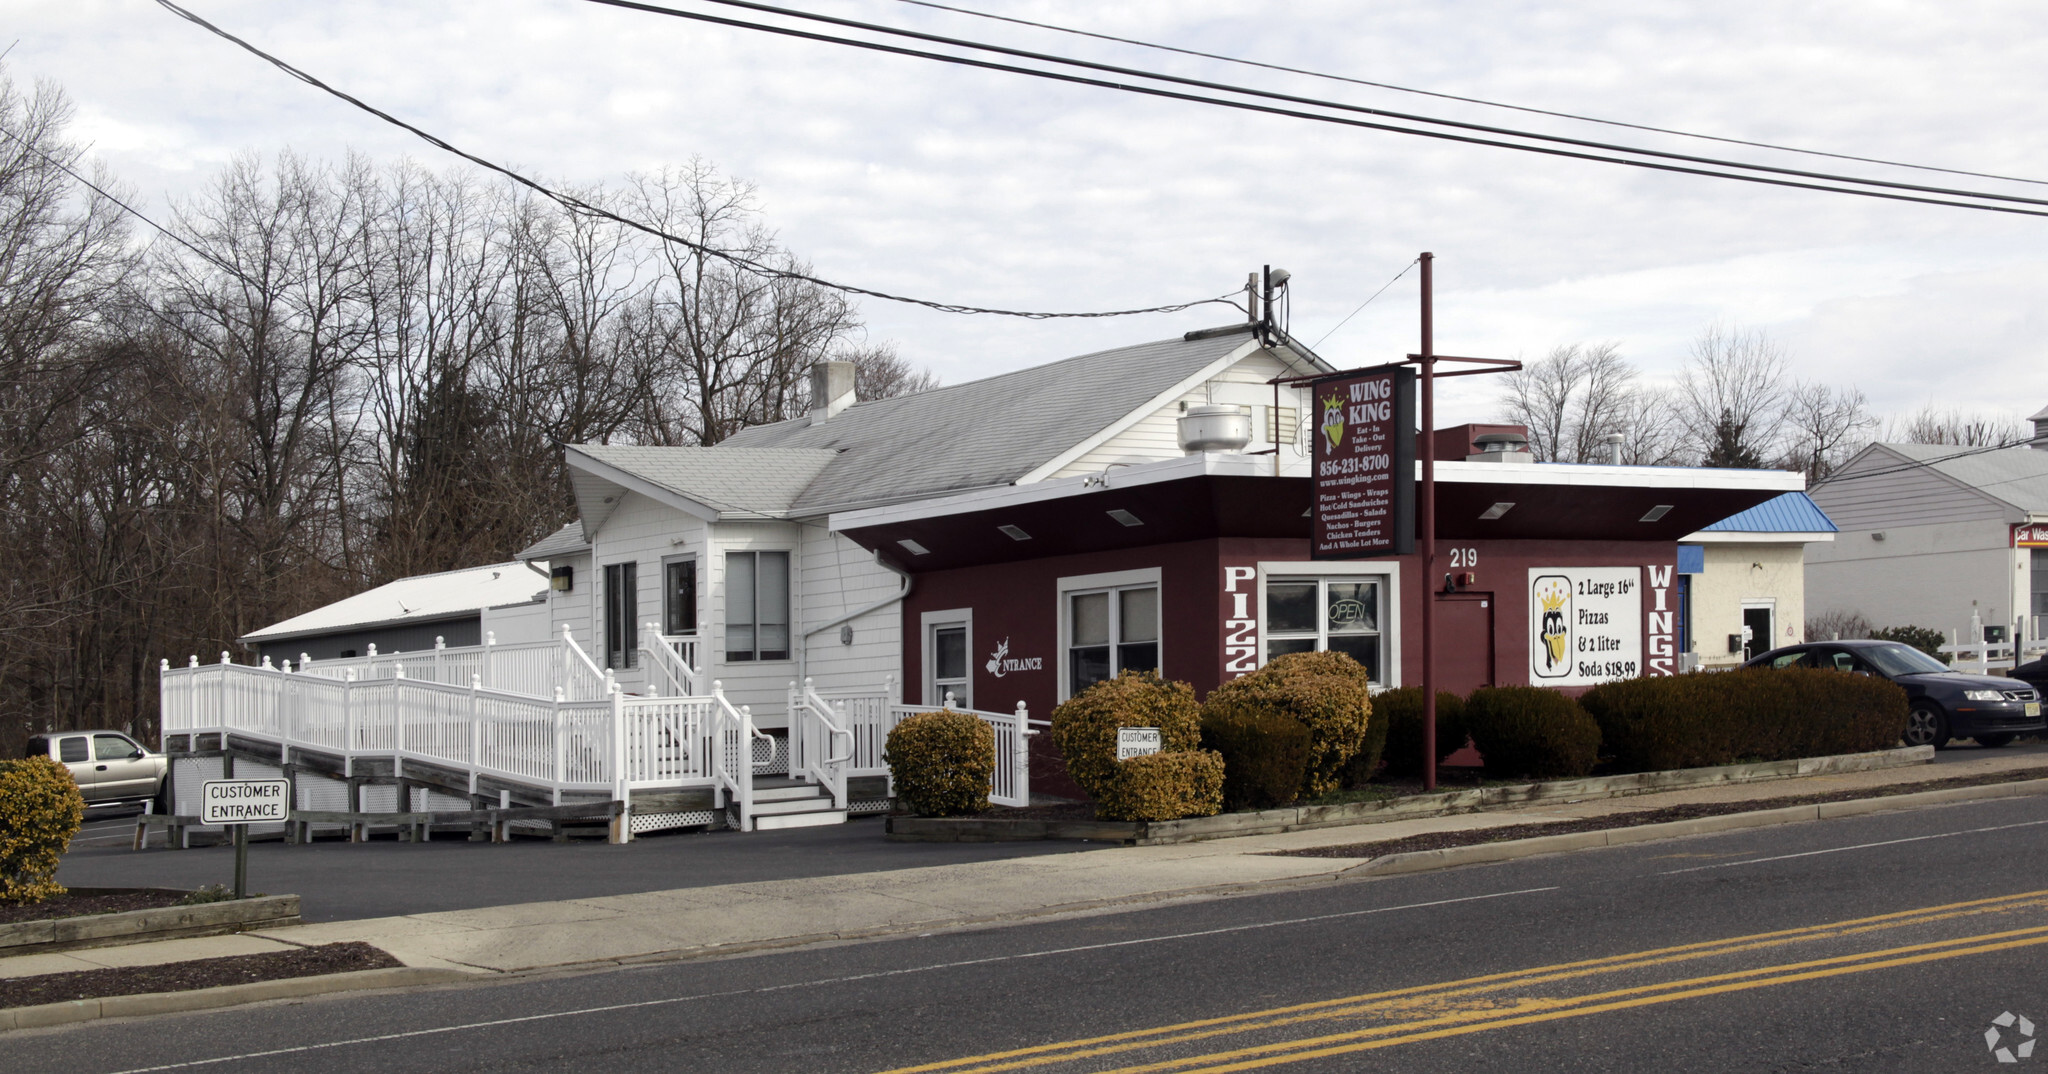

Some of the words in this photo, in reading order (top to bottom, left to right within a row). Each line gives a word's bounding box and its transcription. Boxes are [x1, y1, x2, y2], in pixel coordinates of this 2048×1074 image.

[1350, 379, 1391, 403] WING
[1349, 401, 1391, 425] KING
[1352, 436, 1367, 444] Take
[1354, 444, 1382, 453] Delivery
[1320, 454, 1389, 476] 856-231-8700
[1320, 474, 1389, 487] www.wingking.com
[1341, 492, 1361, 500] Wings
[1349, 499, 1388, 508] Sandwiches
[1322, 511, 1358, 521] Quesadillas
[1364, 508, 1386, 516] Salads
[1326, 522, 1349, 530] Nachos
[1327, 532, 1352, 540] Chicken
[1354, 529, 1380, 538] Tenders
[1320, 542, 1332, 550] And
[1340, 540, 1359, 548] Whole
[1450, 548, 1477, 568] 219
[1578, 581, 1584, 595] 2
[1587, 579, 1614, 598] Large
[1328, 604, 1366, 620] OPEN
[1578, 609, 1608, 624] Pizzas
[1224, 566, 1256, 680] PIZZ
[1648, 565, 1674, 678] WINGS
[1578, 636, 1586, 652] &
[1589, 638, 1594, 652] 2
[1598, 636, 1620, 651] liter
[1578, 661, 1602, 677] Soda
[1605, 661, 1636, 677] $18.99
[1122, 732, 1158, 742] CUSTOMER
[212, 785, 280, 798] CUSTOMER
[212, 804, 278, 818] ENTRANCE
